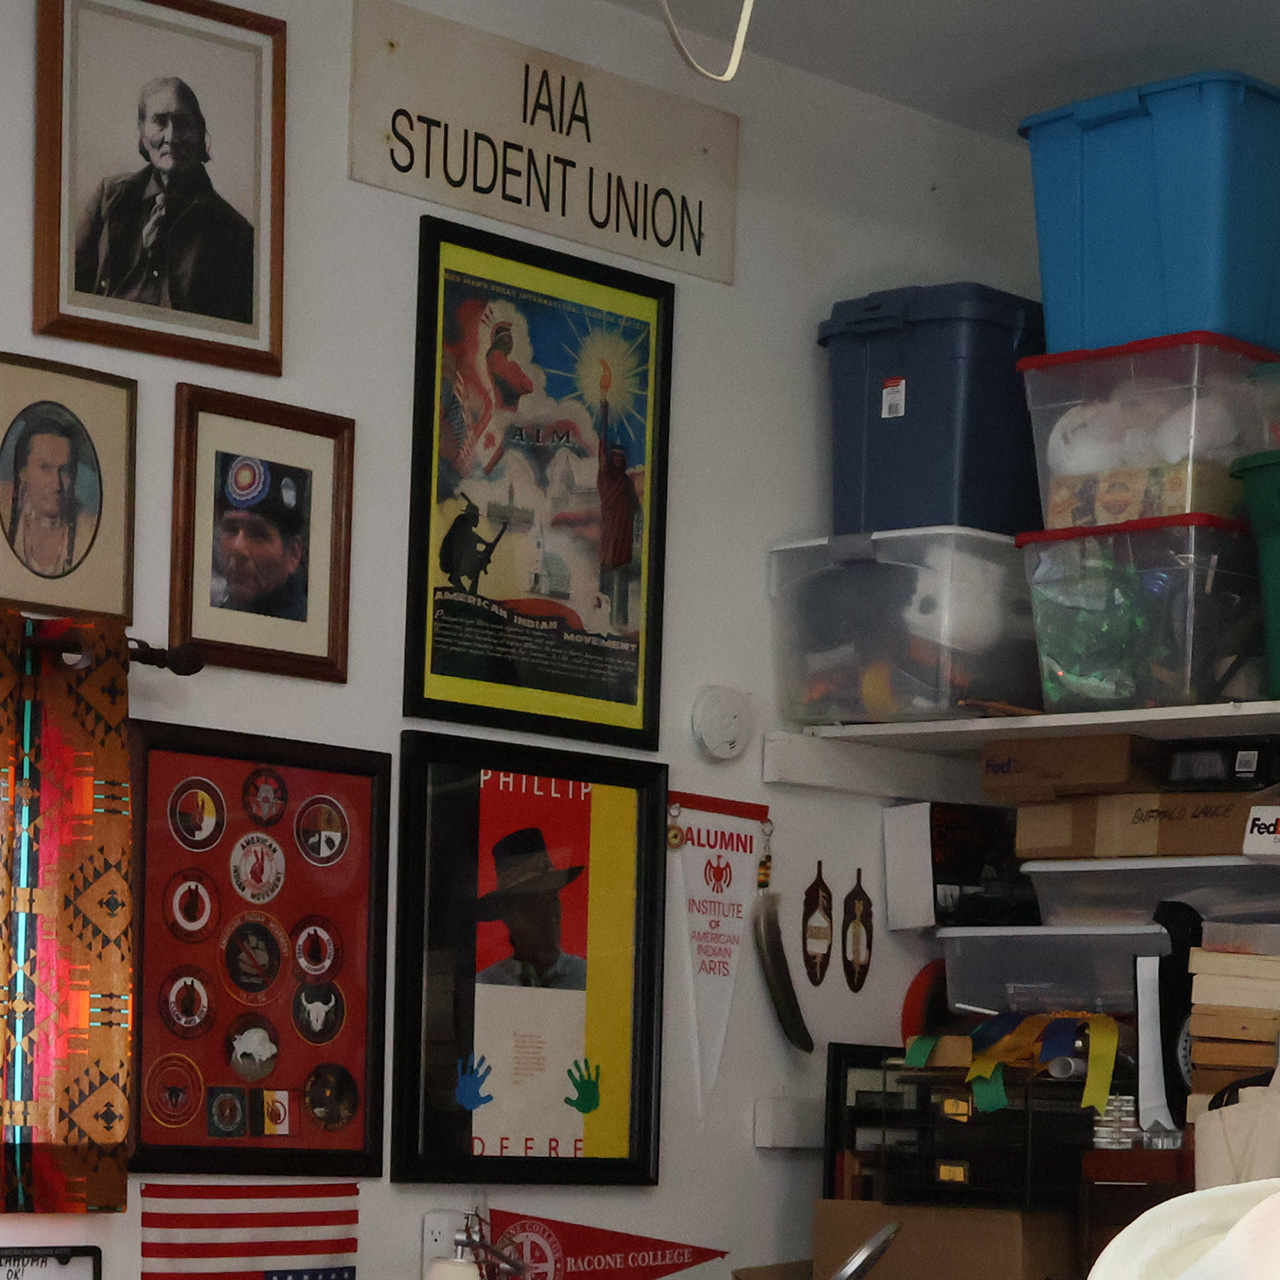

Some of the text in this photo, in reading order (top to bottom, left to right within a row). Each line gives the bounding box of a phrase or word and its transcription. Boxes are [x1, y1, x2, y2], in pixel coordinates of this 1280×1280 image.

[522, 63, 591, 143] IAIA
[390, 108, 703, 257] STUDENT UNION
[434, 590, 508, 619] AMERICAN
[513, 614, 558, 631] INDIAN
[480, 768, 592, 801] PHILLIP
[683, 825, 755, 855] ALUMNI
[688, 897, 744, 919] INSTITUTE
[697, 959, 731, 978] ARTS
[565, 1247, 694, 1273] BACONE COLLEGE
